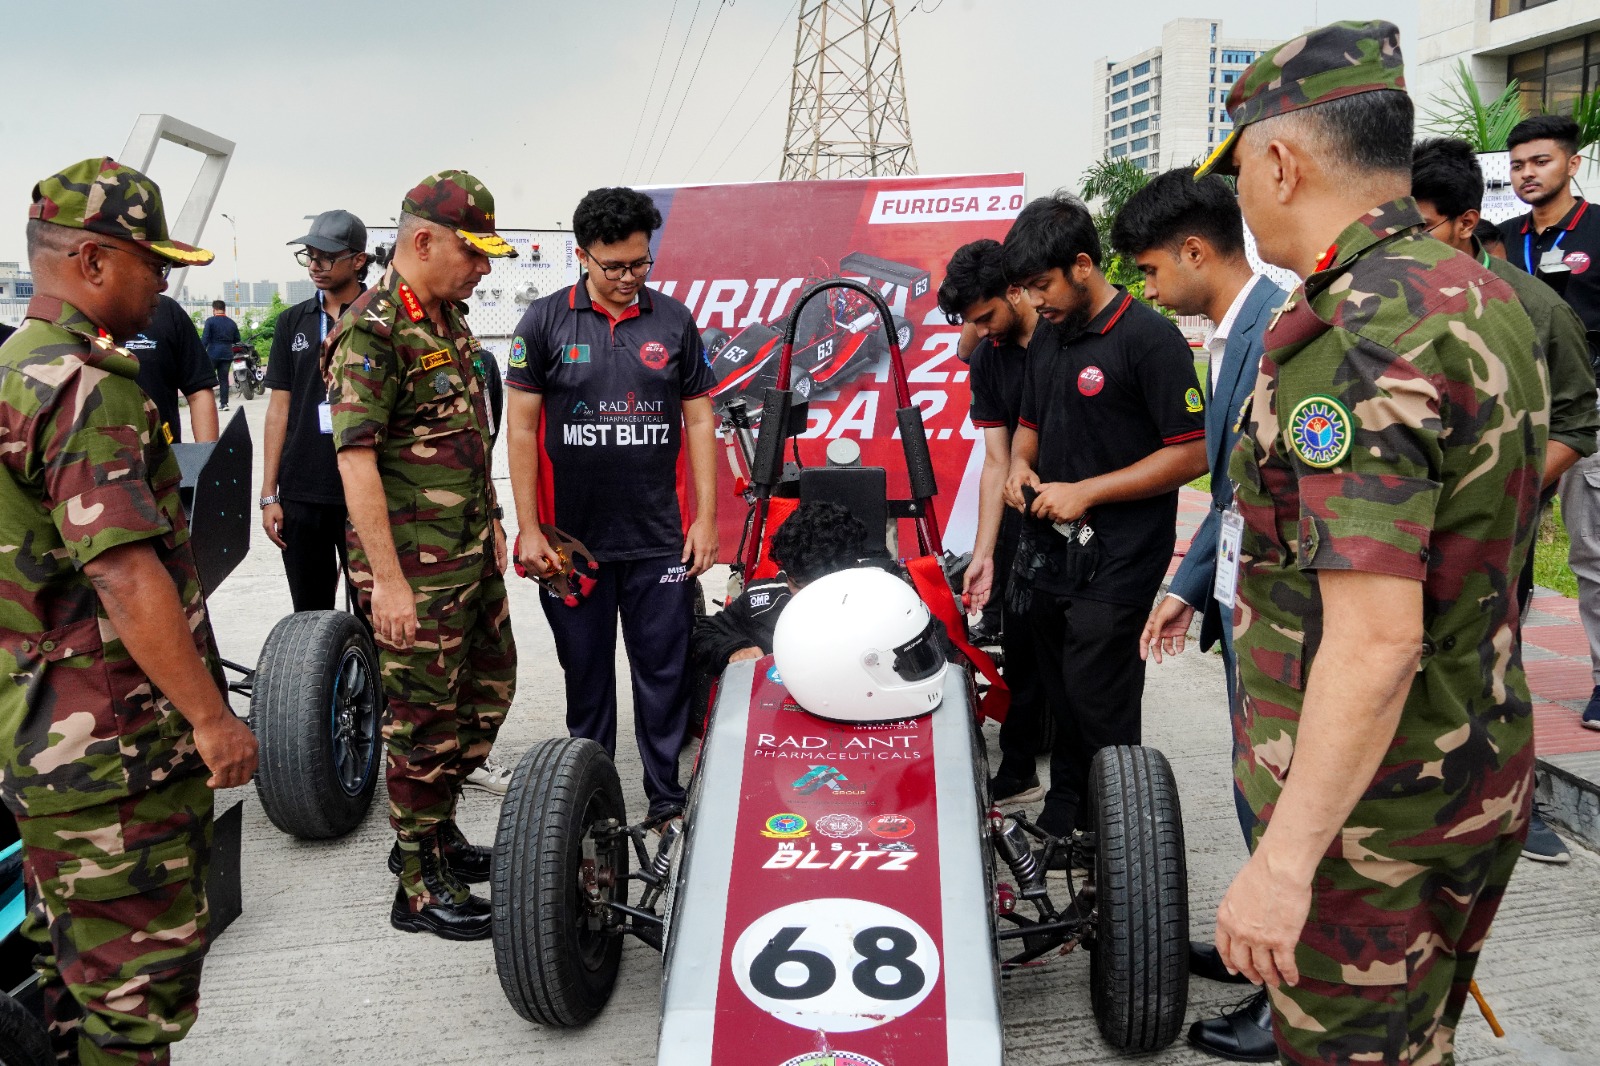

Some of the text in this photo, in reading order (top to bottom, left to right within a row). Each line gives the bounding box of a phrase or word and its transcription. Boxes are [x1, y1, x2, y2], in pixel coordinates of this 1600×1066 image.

[882, 194, 1023, 215] FURIOSA 2.0
[915, 278, 928, 297] 63
[723, 345, 748, 363] 63
[818, 339, 833, 361] 63
[907, 333, 969, 383] 2.
[599, 415, 664, 423] PHARMACEUTICALS
[563, 423, 670, 447] MIST BLITZ
[659, 573, 689, 583] BLIT
[667, 565, 687, 574] MIST
[749, 592, 770, 608] OMP
[754, 749, 921, 760] PHARMACEUTICALS
[778, 842, 870, 851] MIST
[761, 850, 919, 871] BLITZ
[749, 926, 926, 1001] 68
